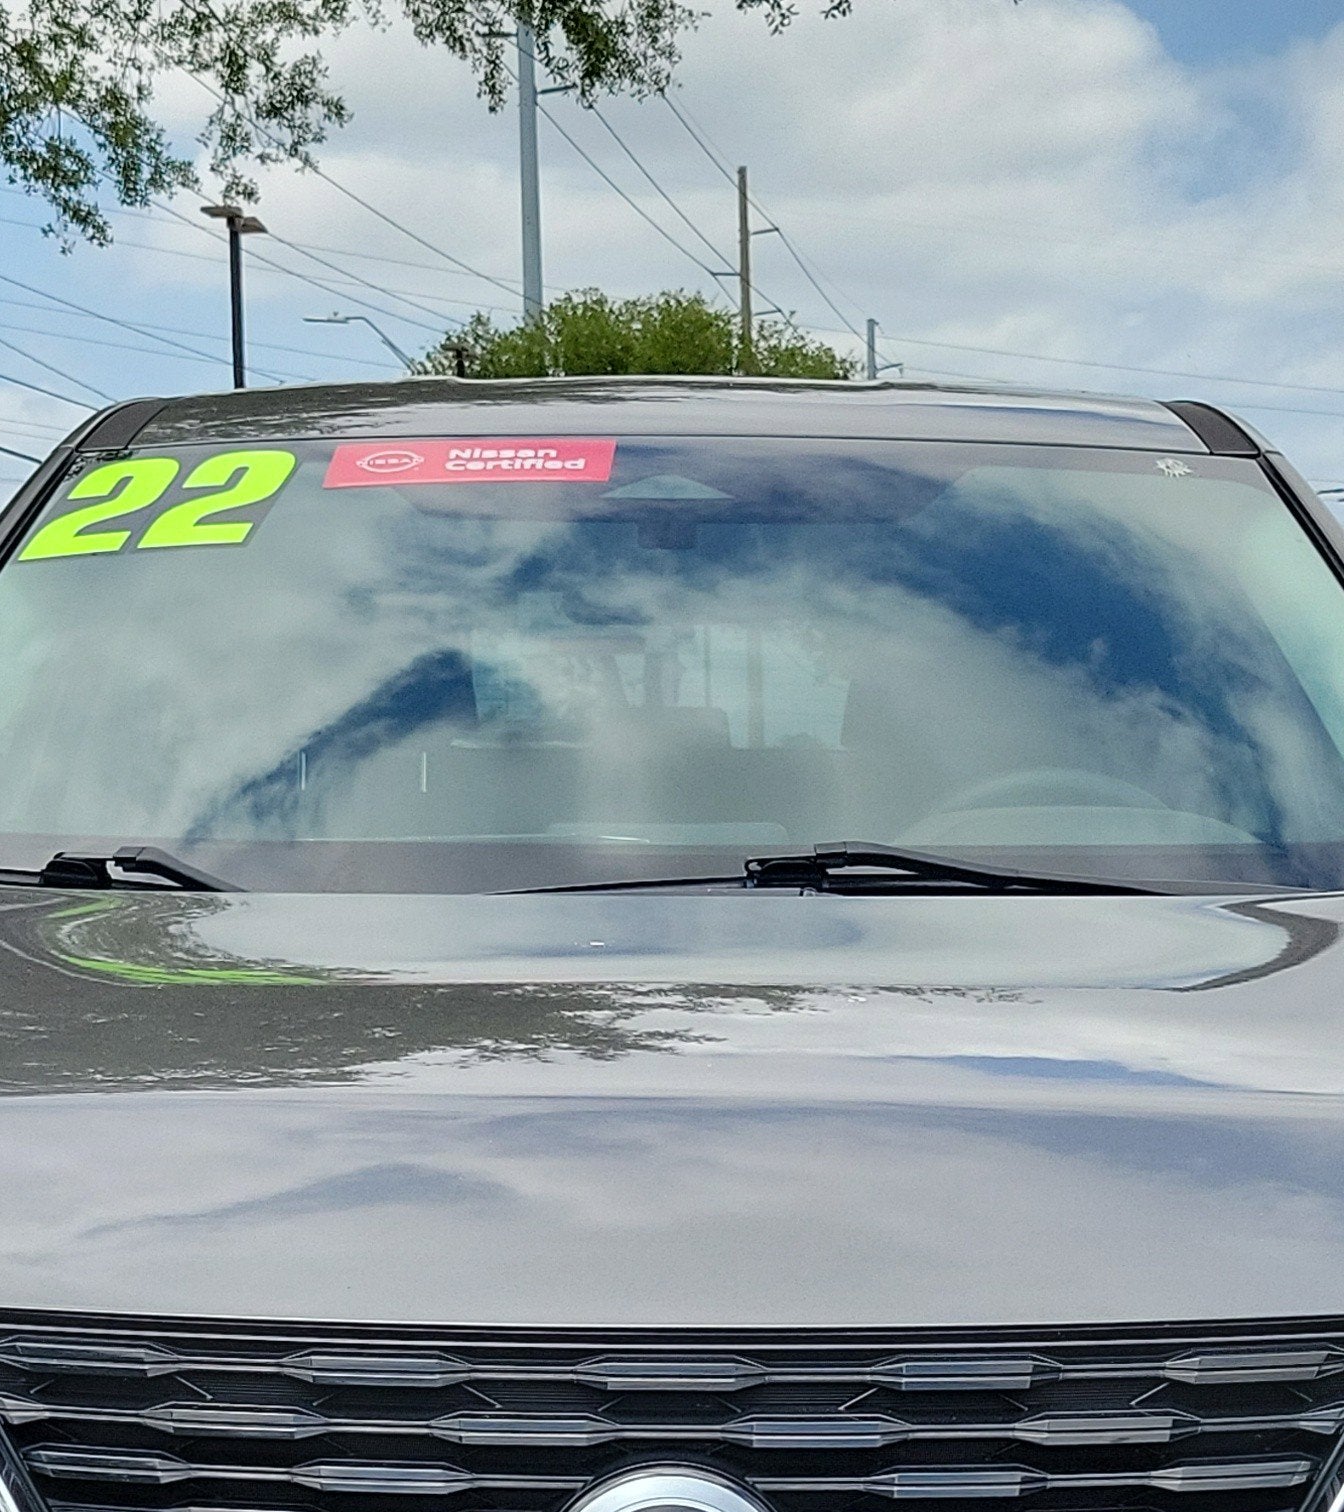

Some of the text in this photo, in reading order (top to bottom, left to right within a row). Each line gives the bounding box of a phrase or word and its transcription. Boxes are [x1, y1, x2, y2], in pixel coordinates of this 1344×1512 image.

[449, 448, 557, 459] Nissan
[445, 458, 586, 471] Certified
[17, 450, 296, 561] 22
